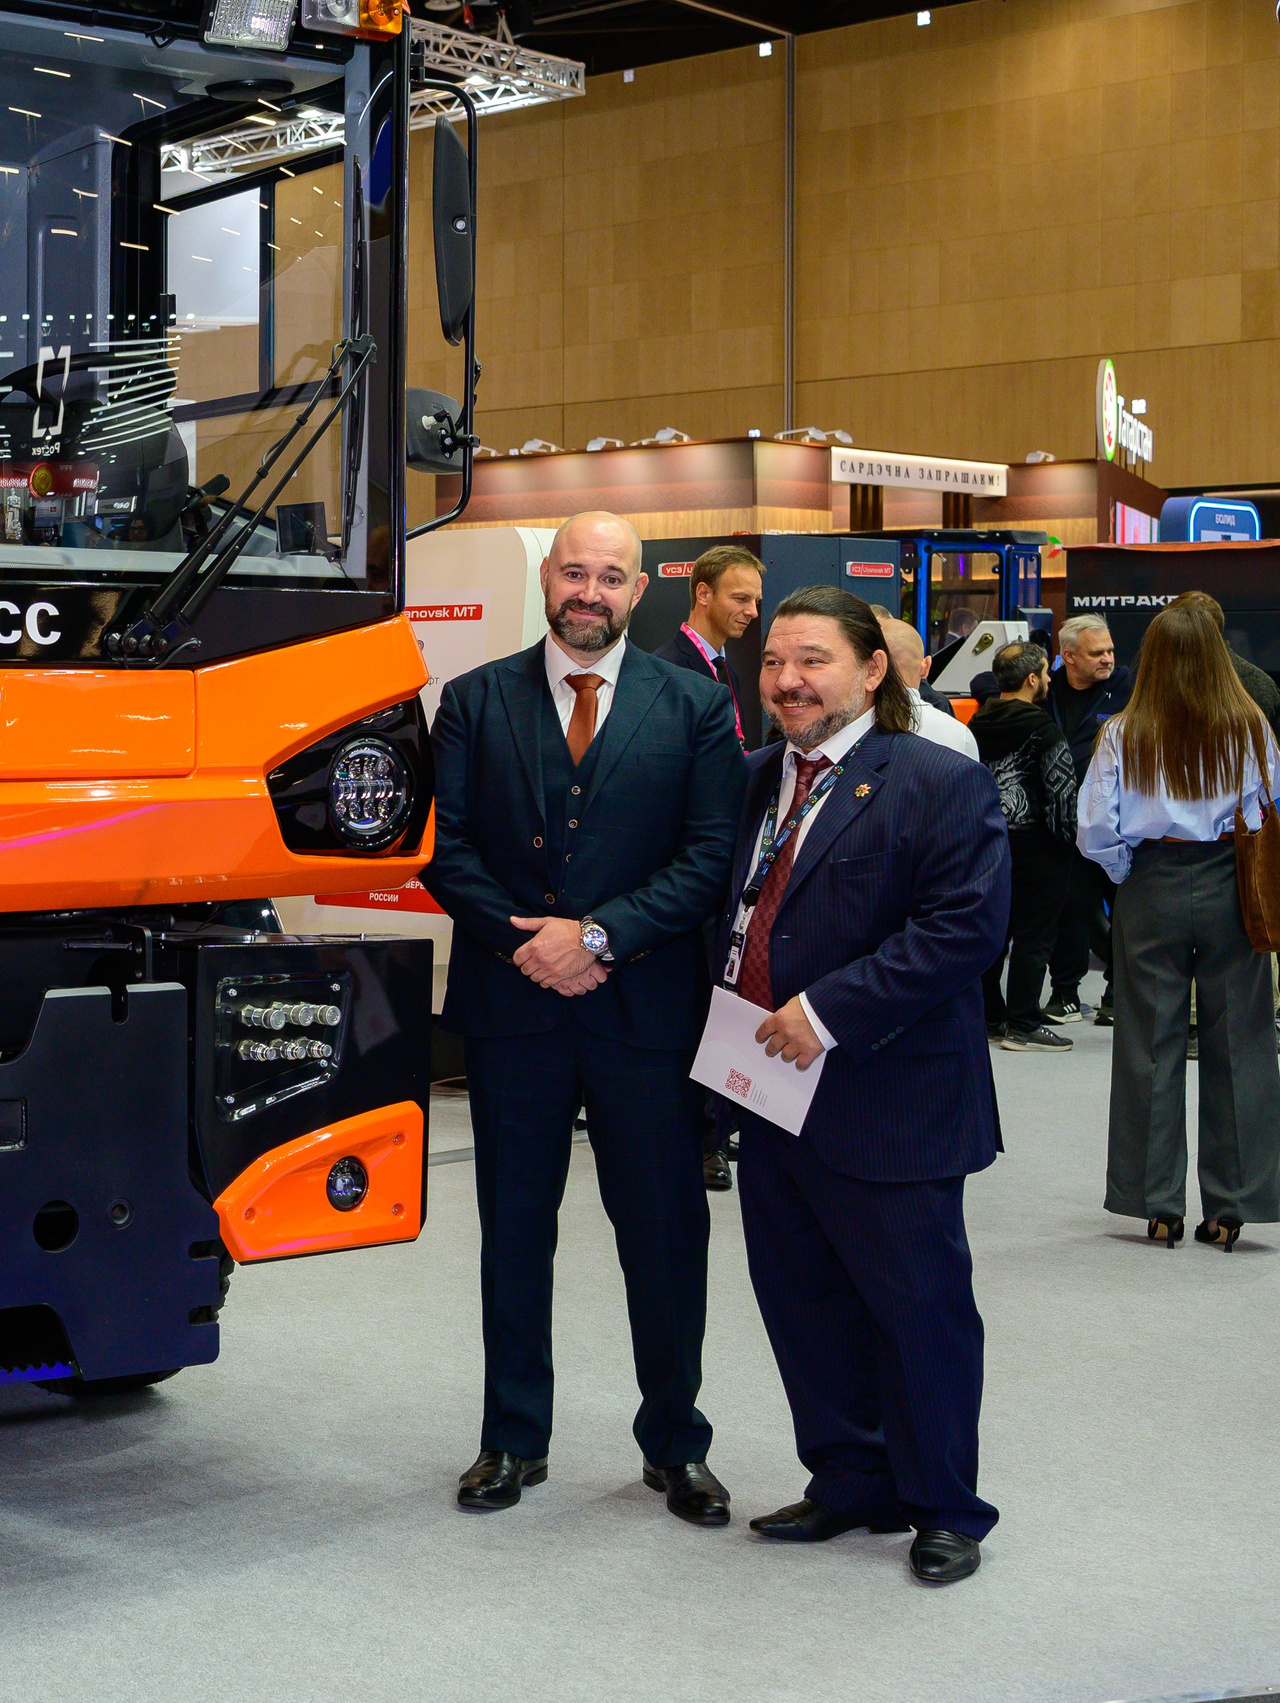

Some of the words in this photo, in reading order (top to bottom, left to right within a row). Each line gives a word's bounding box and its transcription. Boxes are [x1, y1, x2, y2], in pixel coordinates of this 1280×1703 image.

[840, 459, 911, 479] САРДЭЧНА
[918, 467, 1001, 487] ЗАПРАШАЕМ!
[665, 566, 683, 574] УСЗ
[453, 606, 477, 618] MT
[369, 892, 399, 902] РОССИИ
